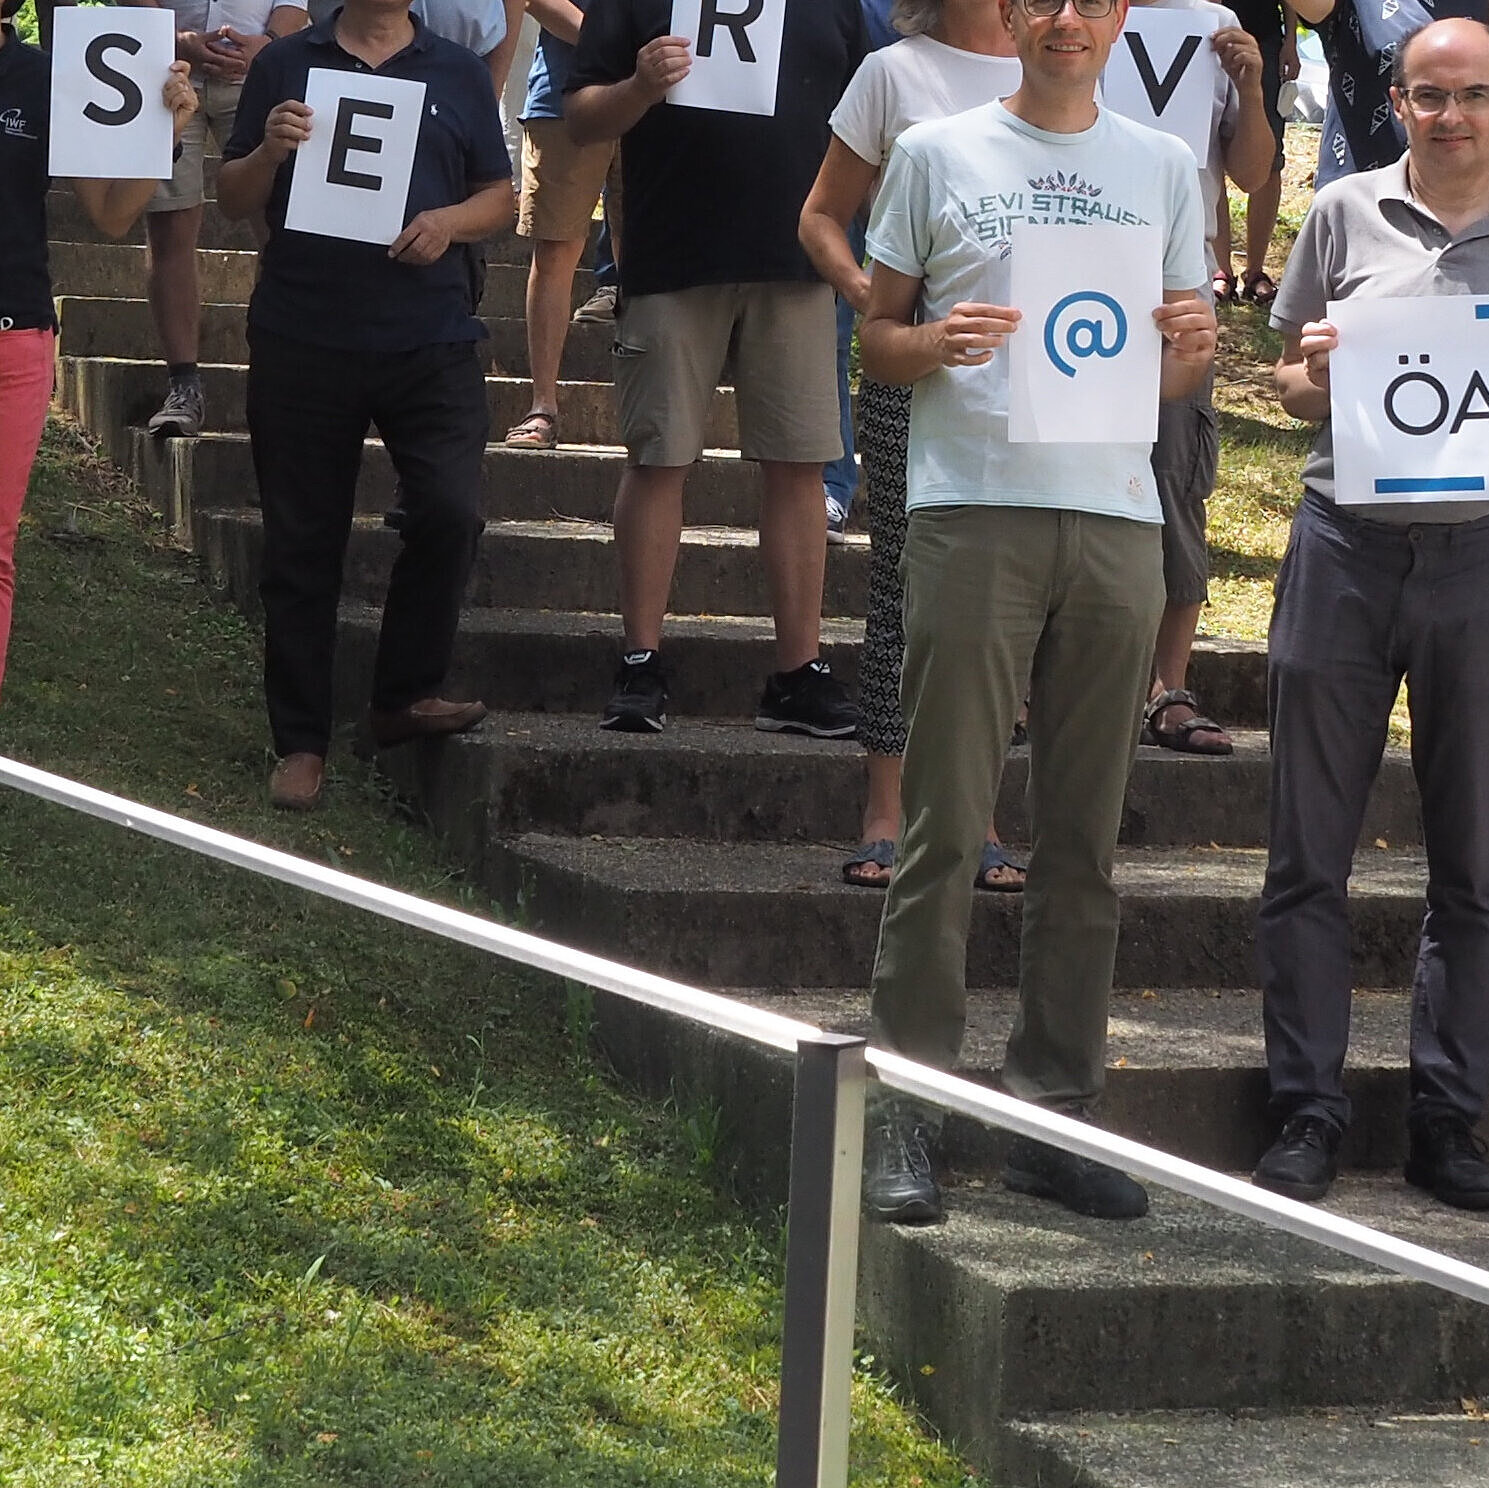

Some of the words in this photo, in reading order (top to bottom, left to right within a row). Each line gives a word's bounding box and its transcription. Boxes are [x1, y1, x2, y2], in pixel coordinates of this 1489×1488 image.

[82, 32, 143, 126] S
[1123, 31, 1203, 118] V
[325, 96, 395, 192] E
[961, 192, 1024, 220] LEVI
[1043, 290, 1129, 378] @
